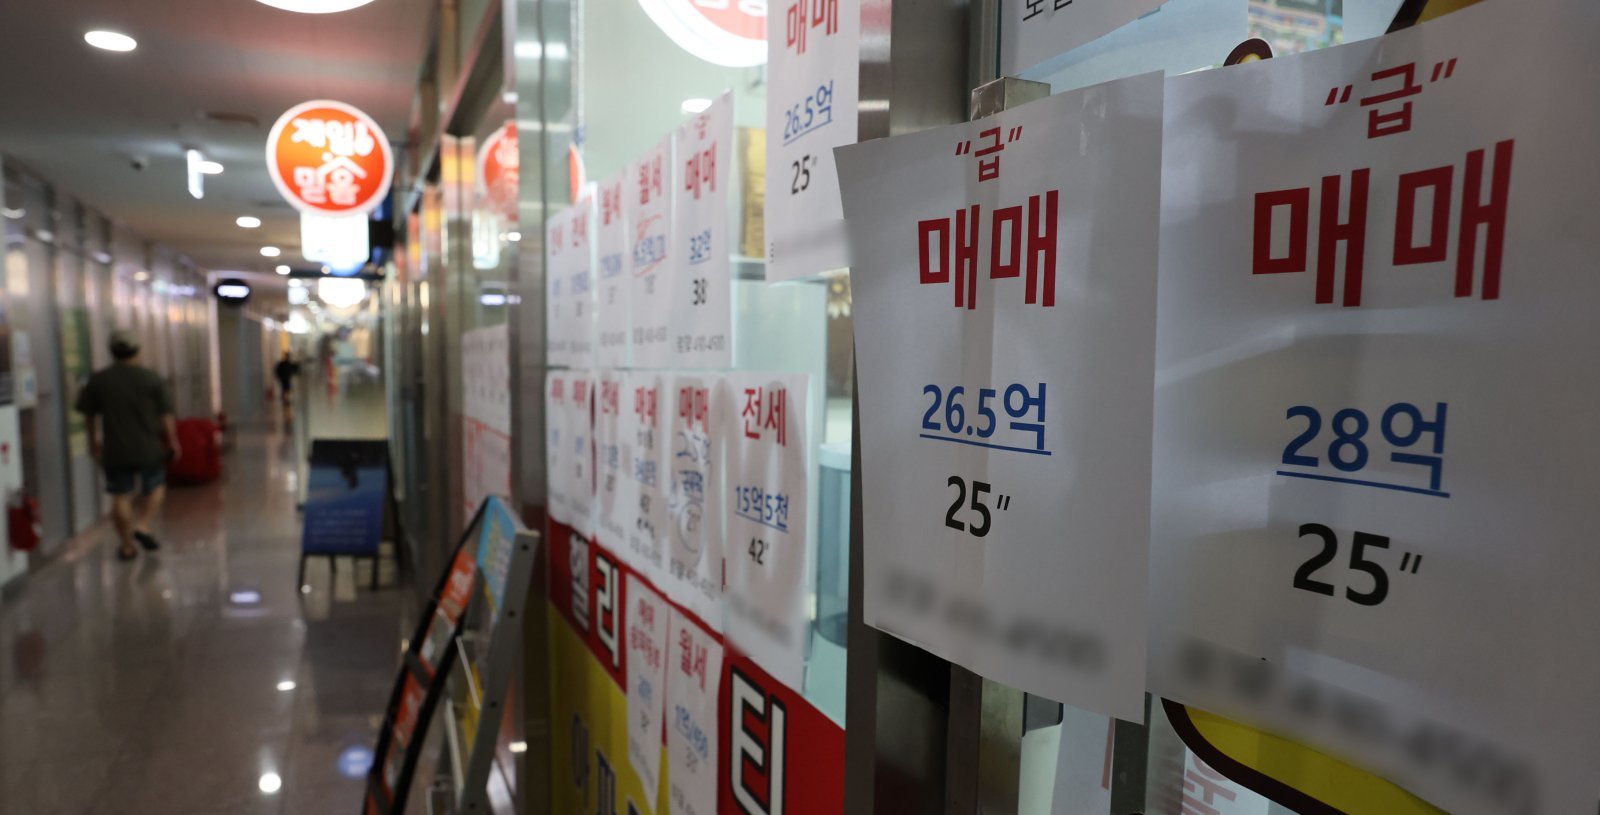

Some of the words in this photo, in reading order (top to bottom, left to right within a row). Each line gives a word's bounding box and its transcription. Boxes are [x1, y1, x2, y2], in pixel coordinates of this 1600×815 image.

[783, 79, 834, 141] 26.5억
[685, 139, 717, 200] 매매
[918, 188, 1060, 310] 매매
[1252, 138, 1515, 307] 매매
[742, 385, 787, 448] 전세
[921, 382, 1049, 454] 26.5억
[1280, 401, 1448, 492] 28억
[735, 486, 789, 530] 15억5천
[680, 628, 708, 693] 월세
